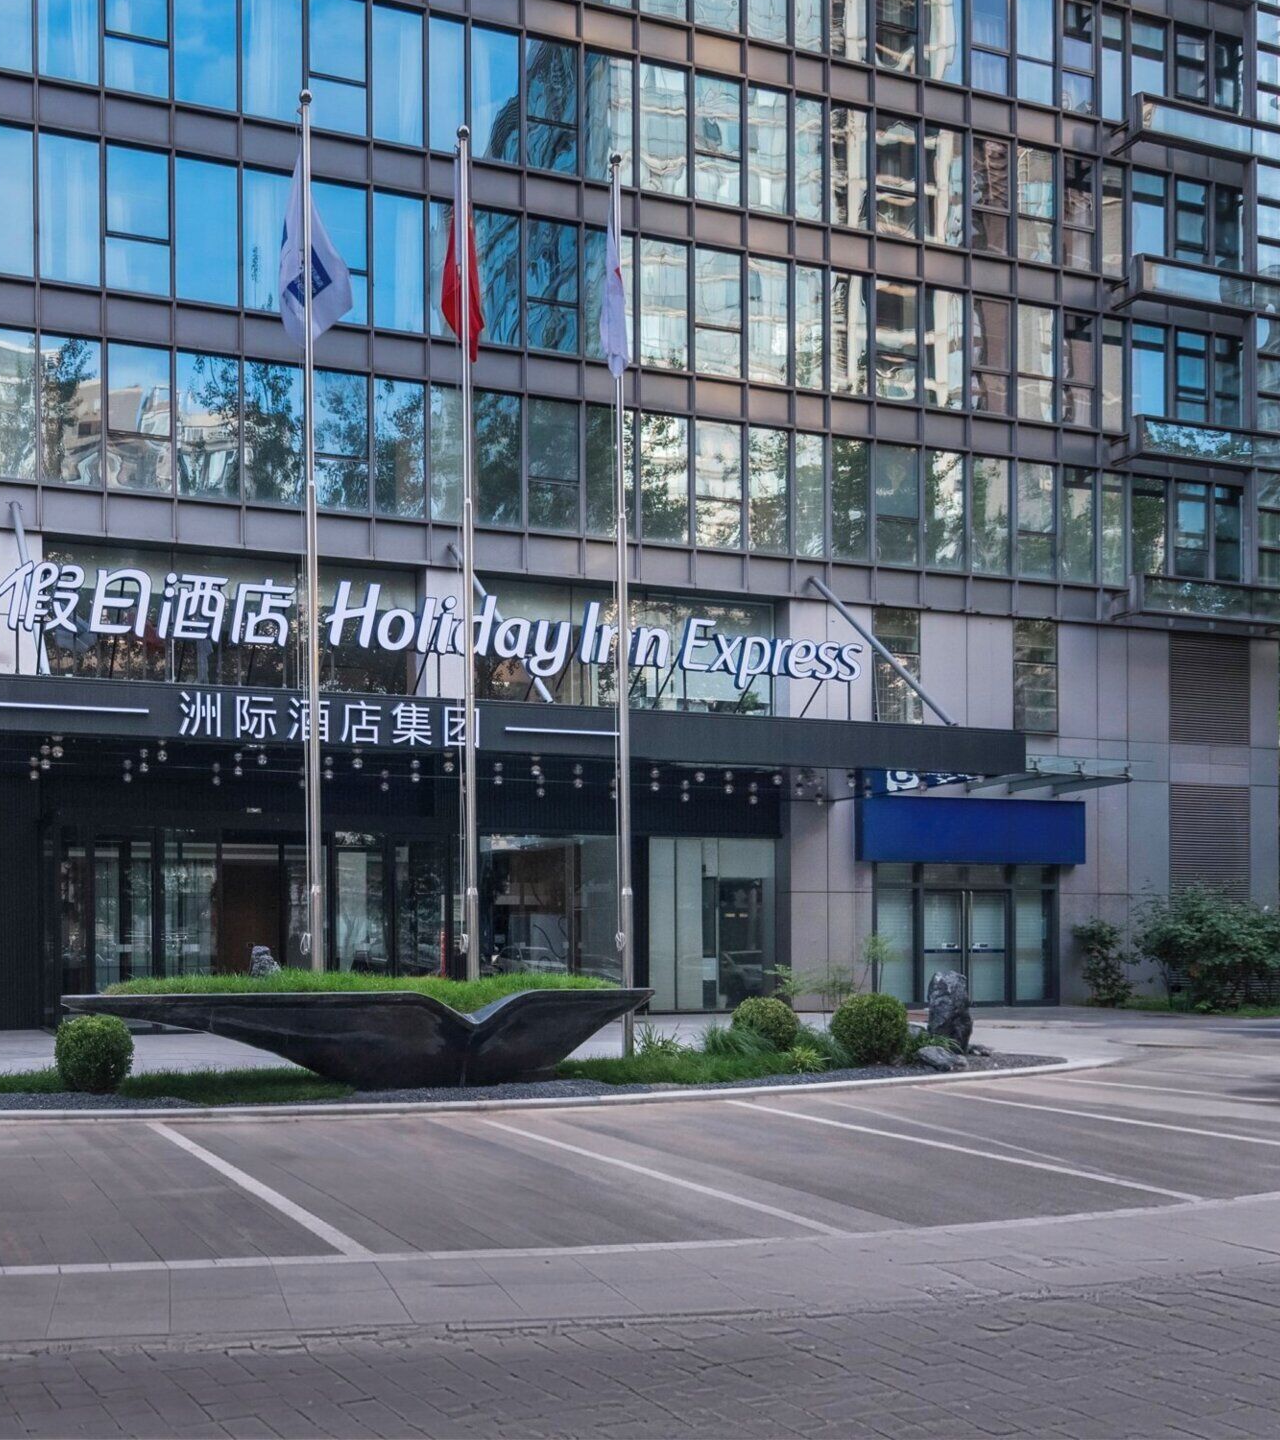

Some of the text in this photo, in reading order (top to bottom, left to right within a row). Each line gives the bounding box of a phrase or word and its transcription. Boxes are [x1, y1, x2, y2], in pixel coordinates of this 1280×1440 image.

[324, 580, 571, 678] Holiday
[578, 601, 670, 668] Inn
[678, 617, 864, 690] Express
[178, 690, 481, 749] 洲际酒店集团
